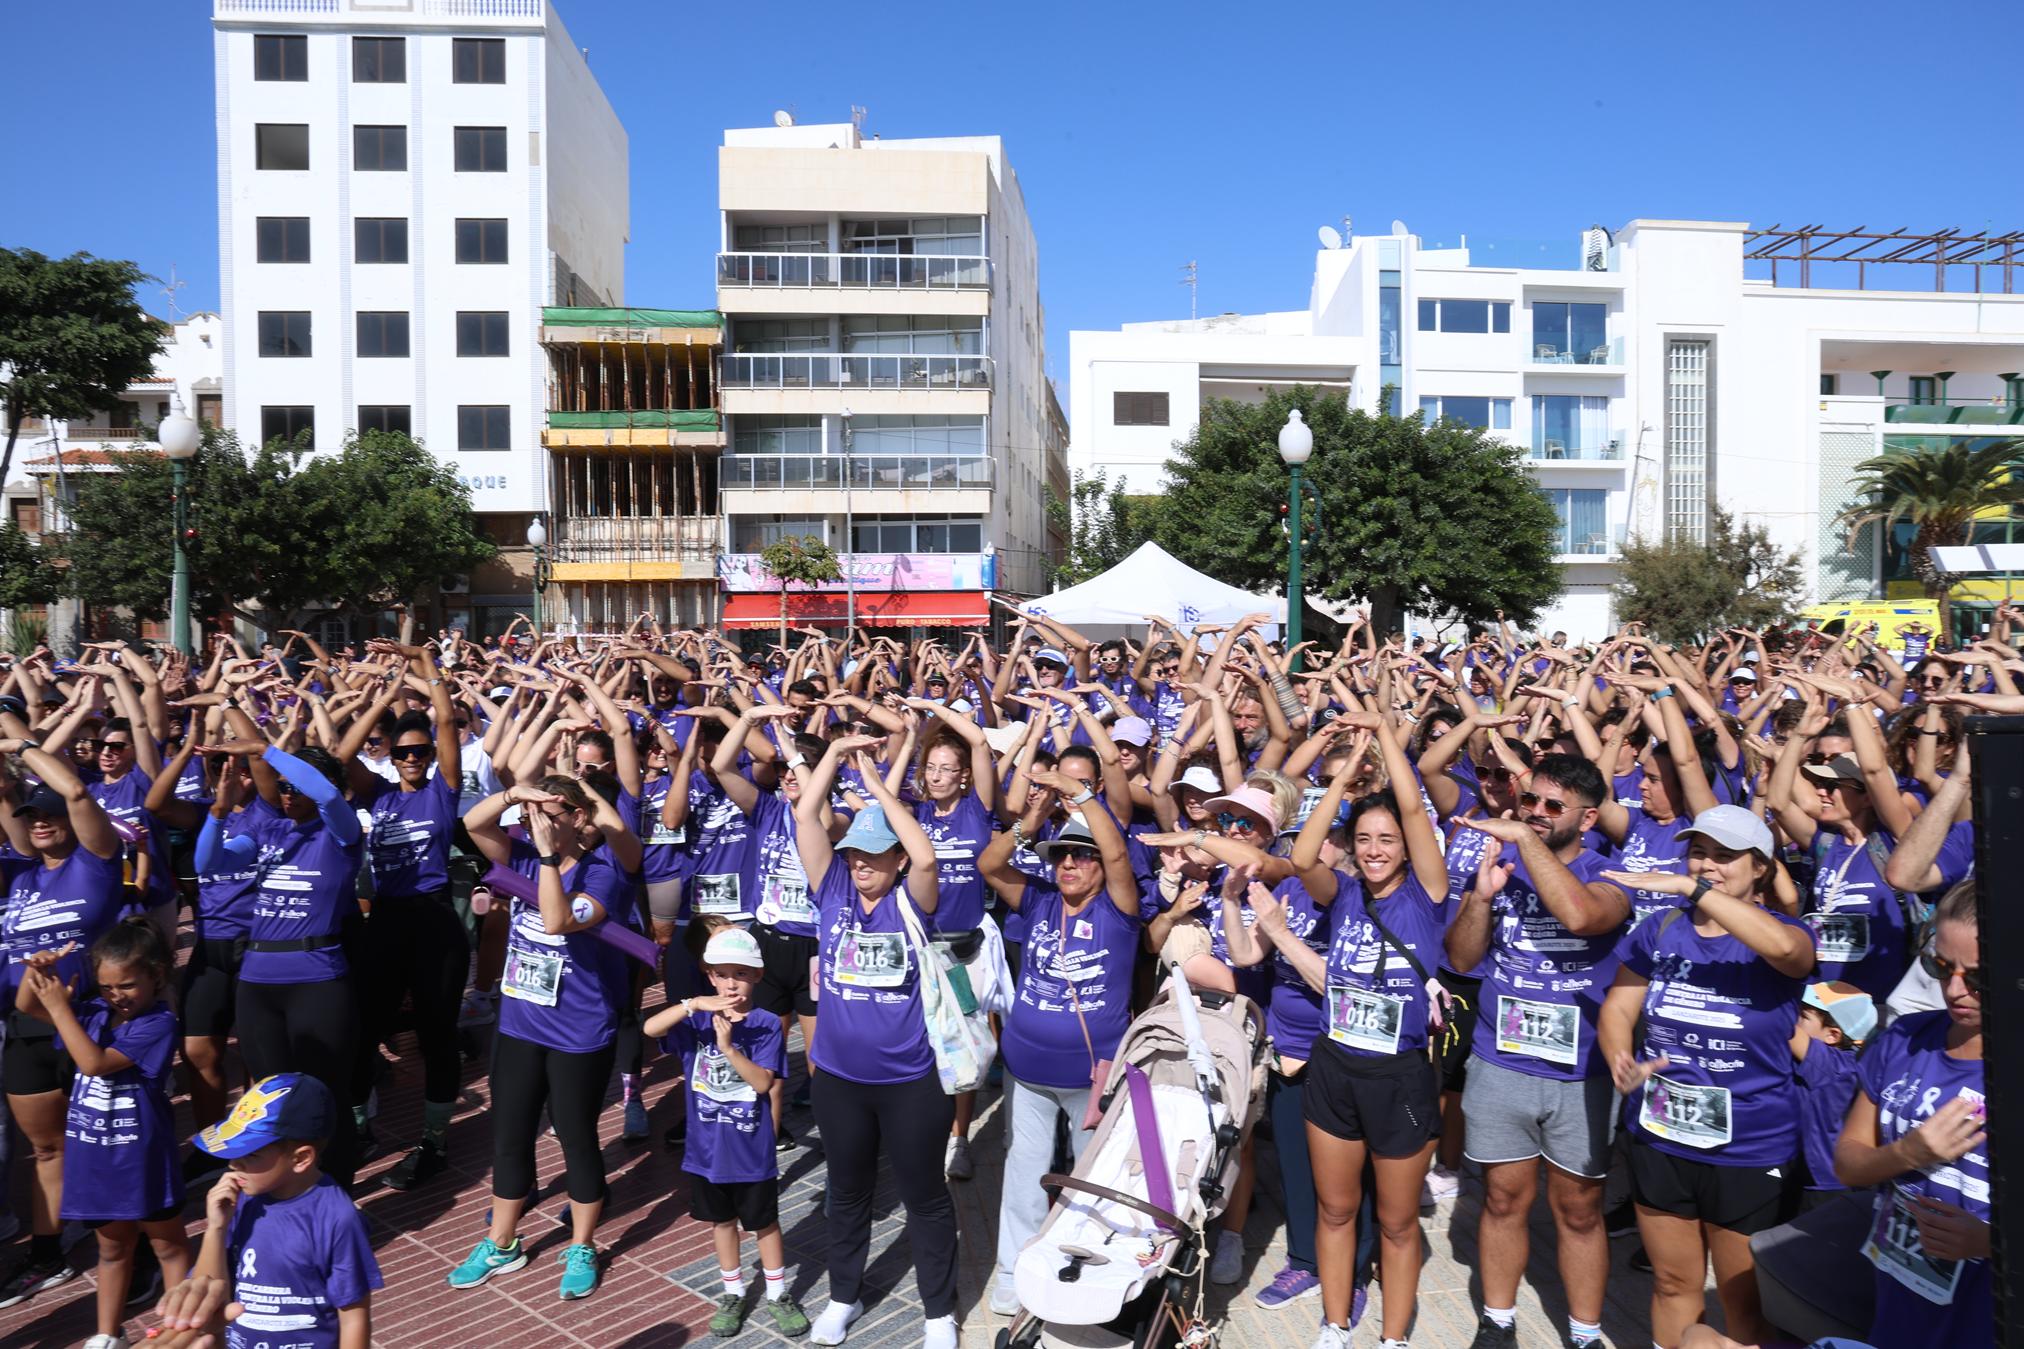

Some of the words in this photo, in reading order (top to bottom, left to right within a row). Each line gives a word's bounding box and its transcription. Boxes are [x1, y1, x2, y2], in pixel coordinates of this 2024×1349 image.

[780, 891, 808, 906] 016
[1820, 929, 1851, 945] 112
[854, 951, 888, 968] 016
[515, 967, 541, 987] 016
[1346, 1006, 1380, 1030] 016
[1519, 1019, 1554, 1040] 112
[707, 1067, 733, 1087] 112
[1663, 1100, 1704, 1126] 112
